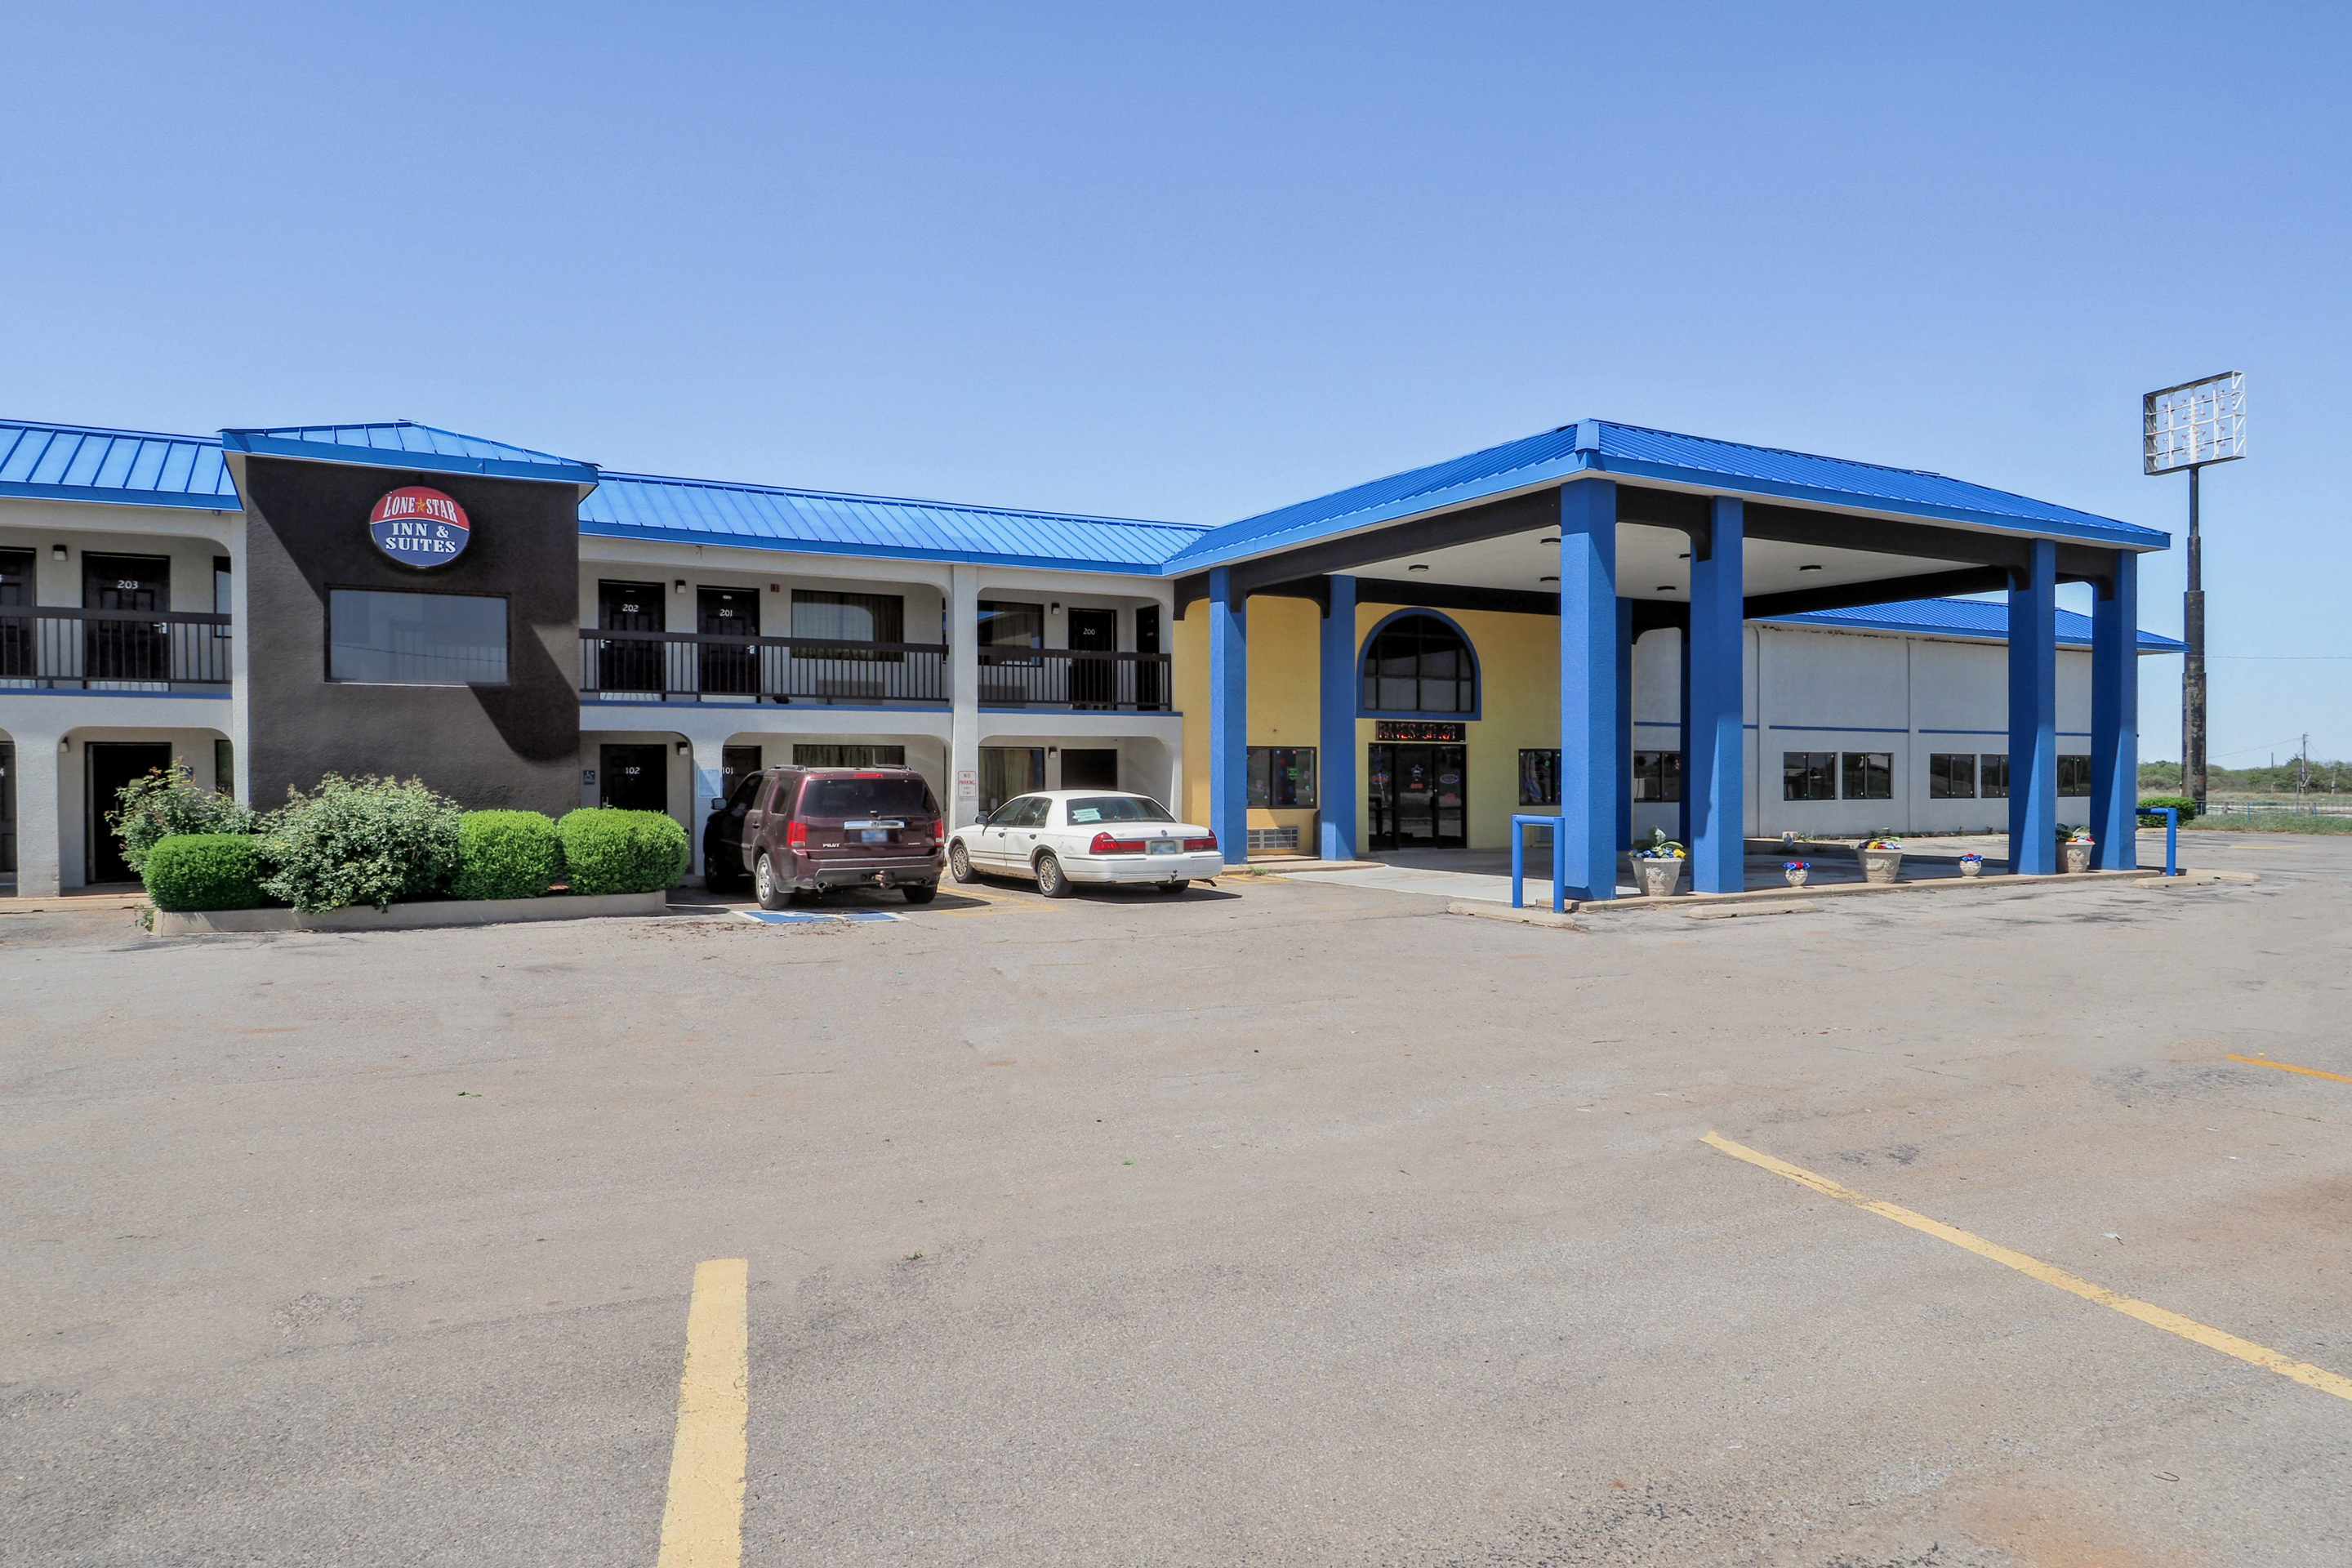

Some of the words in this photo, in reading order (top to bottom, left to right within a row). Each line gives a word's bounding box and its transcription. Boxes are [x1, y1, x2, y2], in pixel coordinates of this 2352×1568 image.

[382, 496, 415, 518] LONE
[425, 498, 458, 523] STAR
[392, 523, 427, 536] INN
[436, 525, 449, 538] &
[385, 537, 456, 553] SUITES
[118, 580, 139, 589] 203
[622, 604, 639, 612] 202
